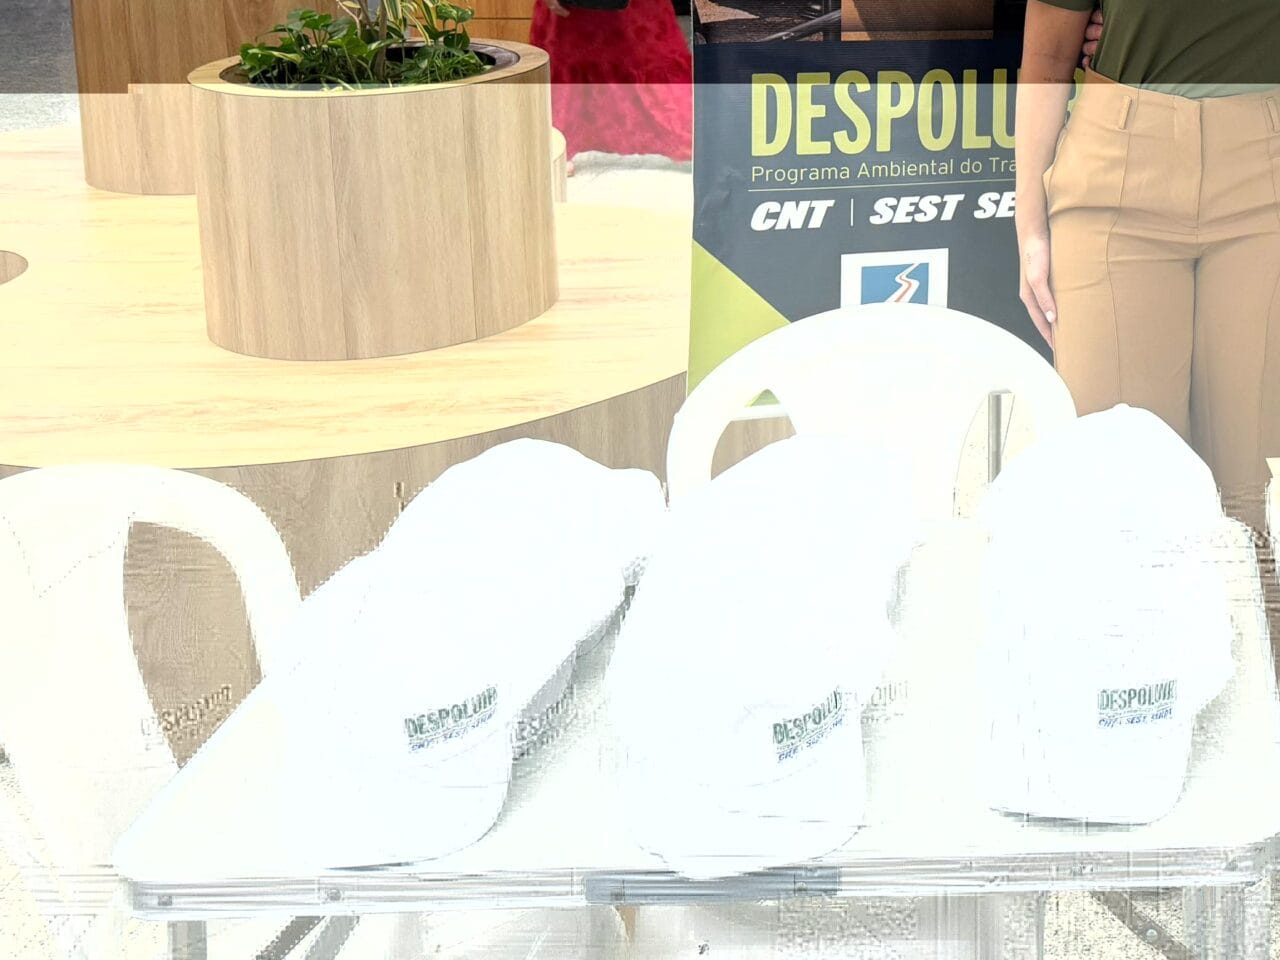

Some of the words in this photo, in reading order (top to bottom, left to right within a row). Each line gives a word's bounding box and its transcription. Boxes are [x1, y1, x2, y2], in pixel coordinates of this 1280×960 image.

[751, 68, 1019, 157] DESPOLU
[752, 165, 850, 185] Programa
[857, 159, 954, 179] Ambiental
[960, 157, 982, 174] do
[988, 156, 1016, 173] Tra
[750, 199, 835, 232] CNT
[869, 193, 966, 225] SEST
[973, 191, 1016, 219] SE
[404, 686, 498, 738] DESPOLUIR
[1098, 679, 1177, 710] DESPOLUIR
